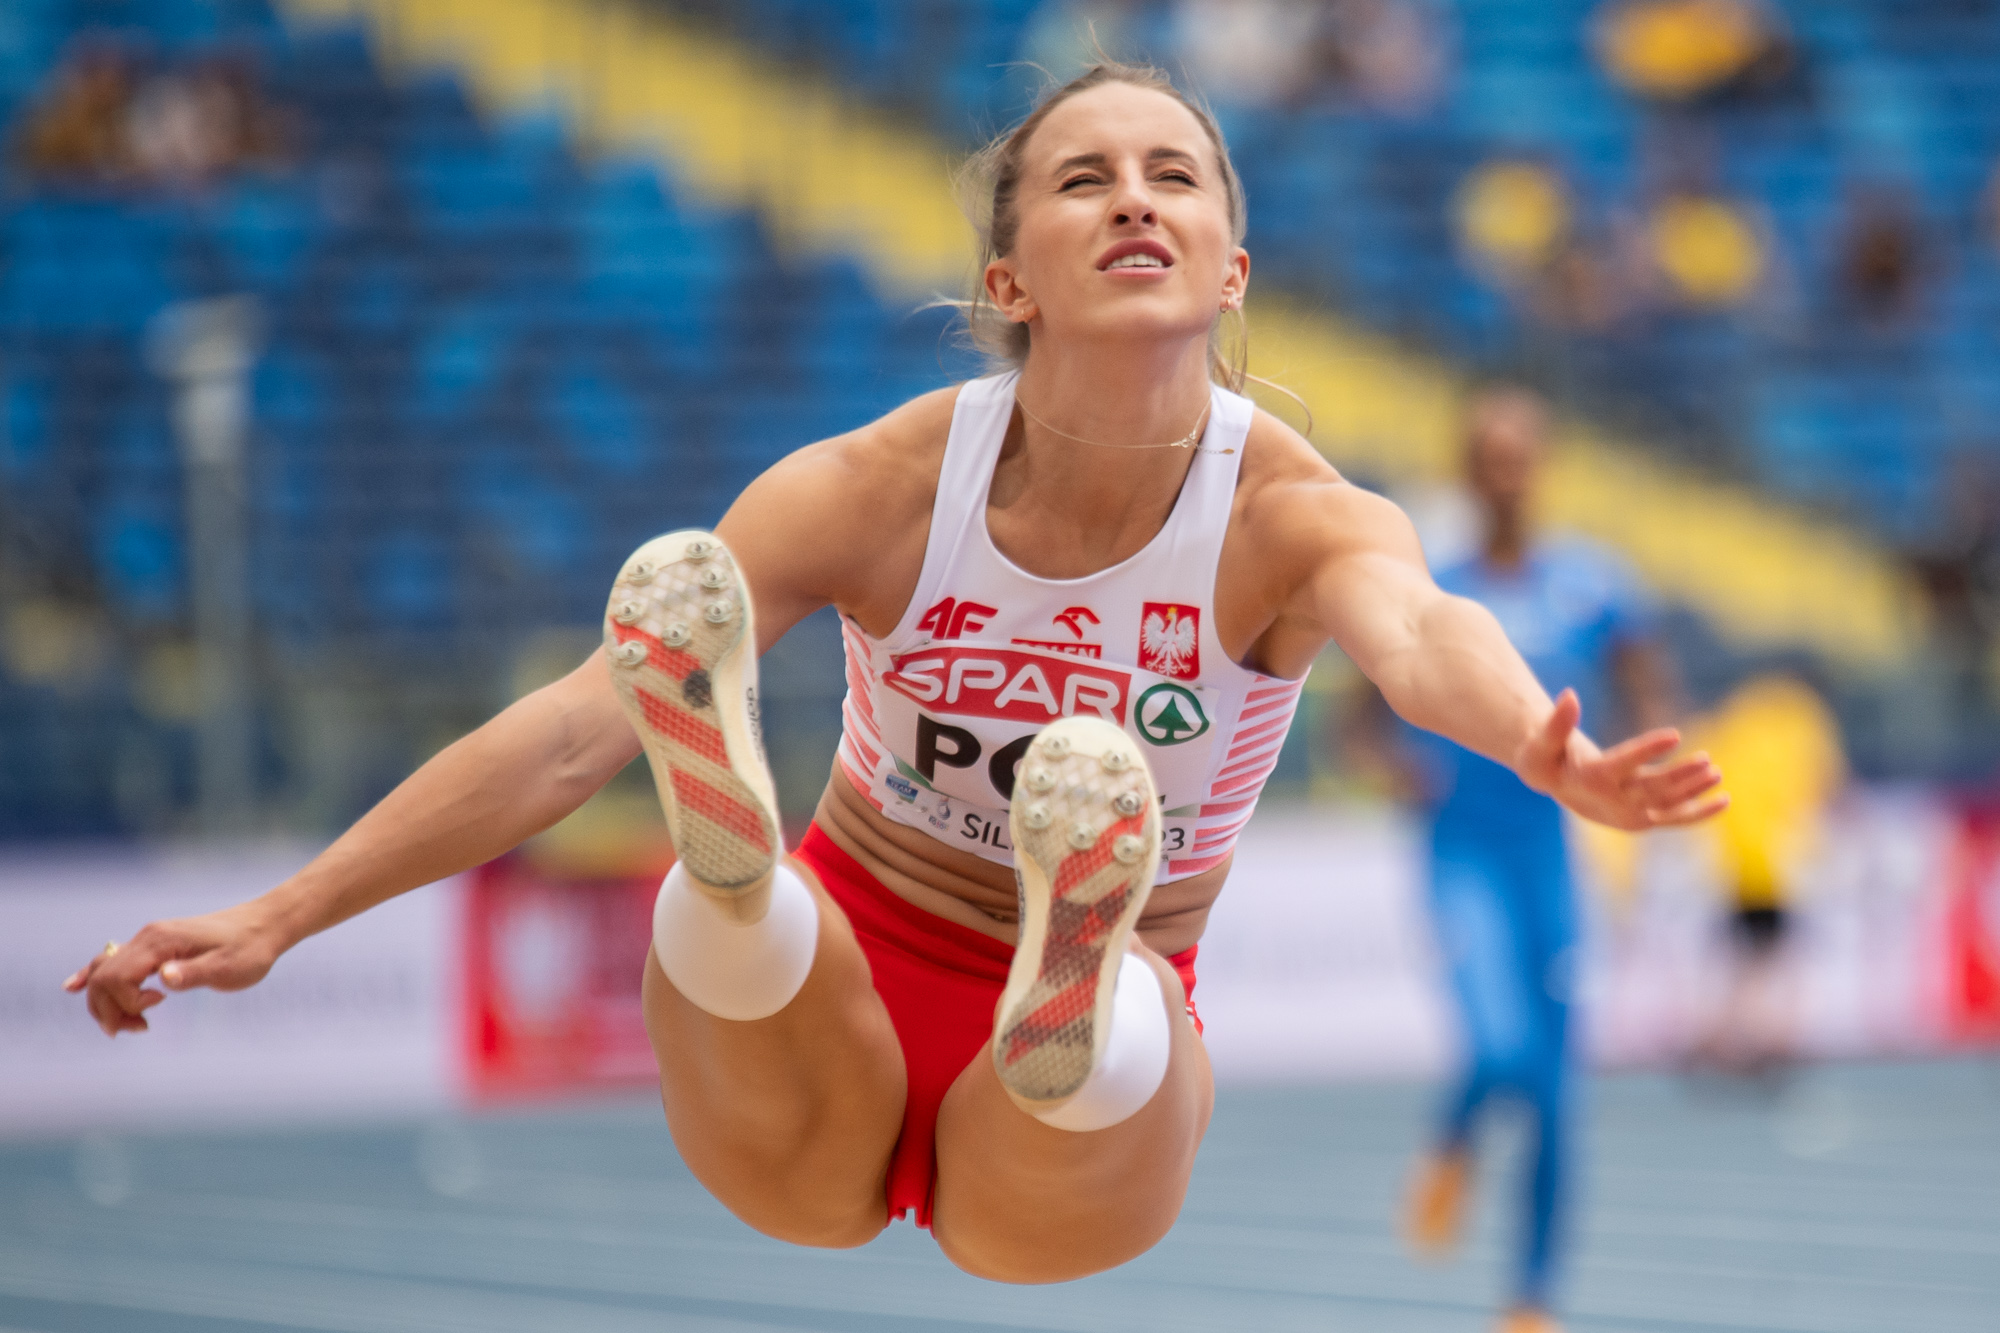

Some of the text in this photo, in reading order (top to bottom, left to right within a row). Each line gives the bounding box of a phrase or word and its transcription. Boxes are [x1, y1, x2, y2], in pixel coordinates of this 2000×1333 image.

[916, 597, 998, 640] 4F
[889, 658, 1120, 724] SPAR
[960, 813, 1015, 851] SIL
[1162, 827, 1185, 851] 3
